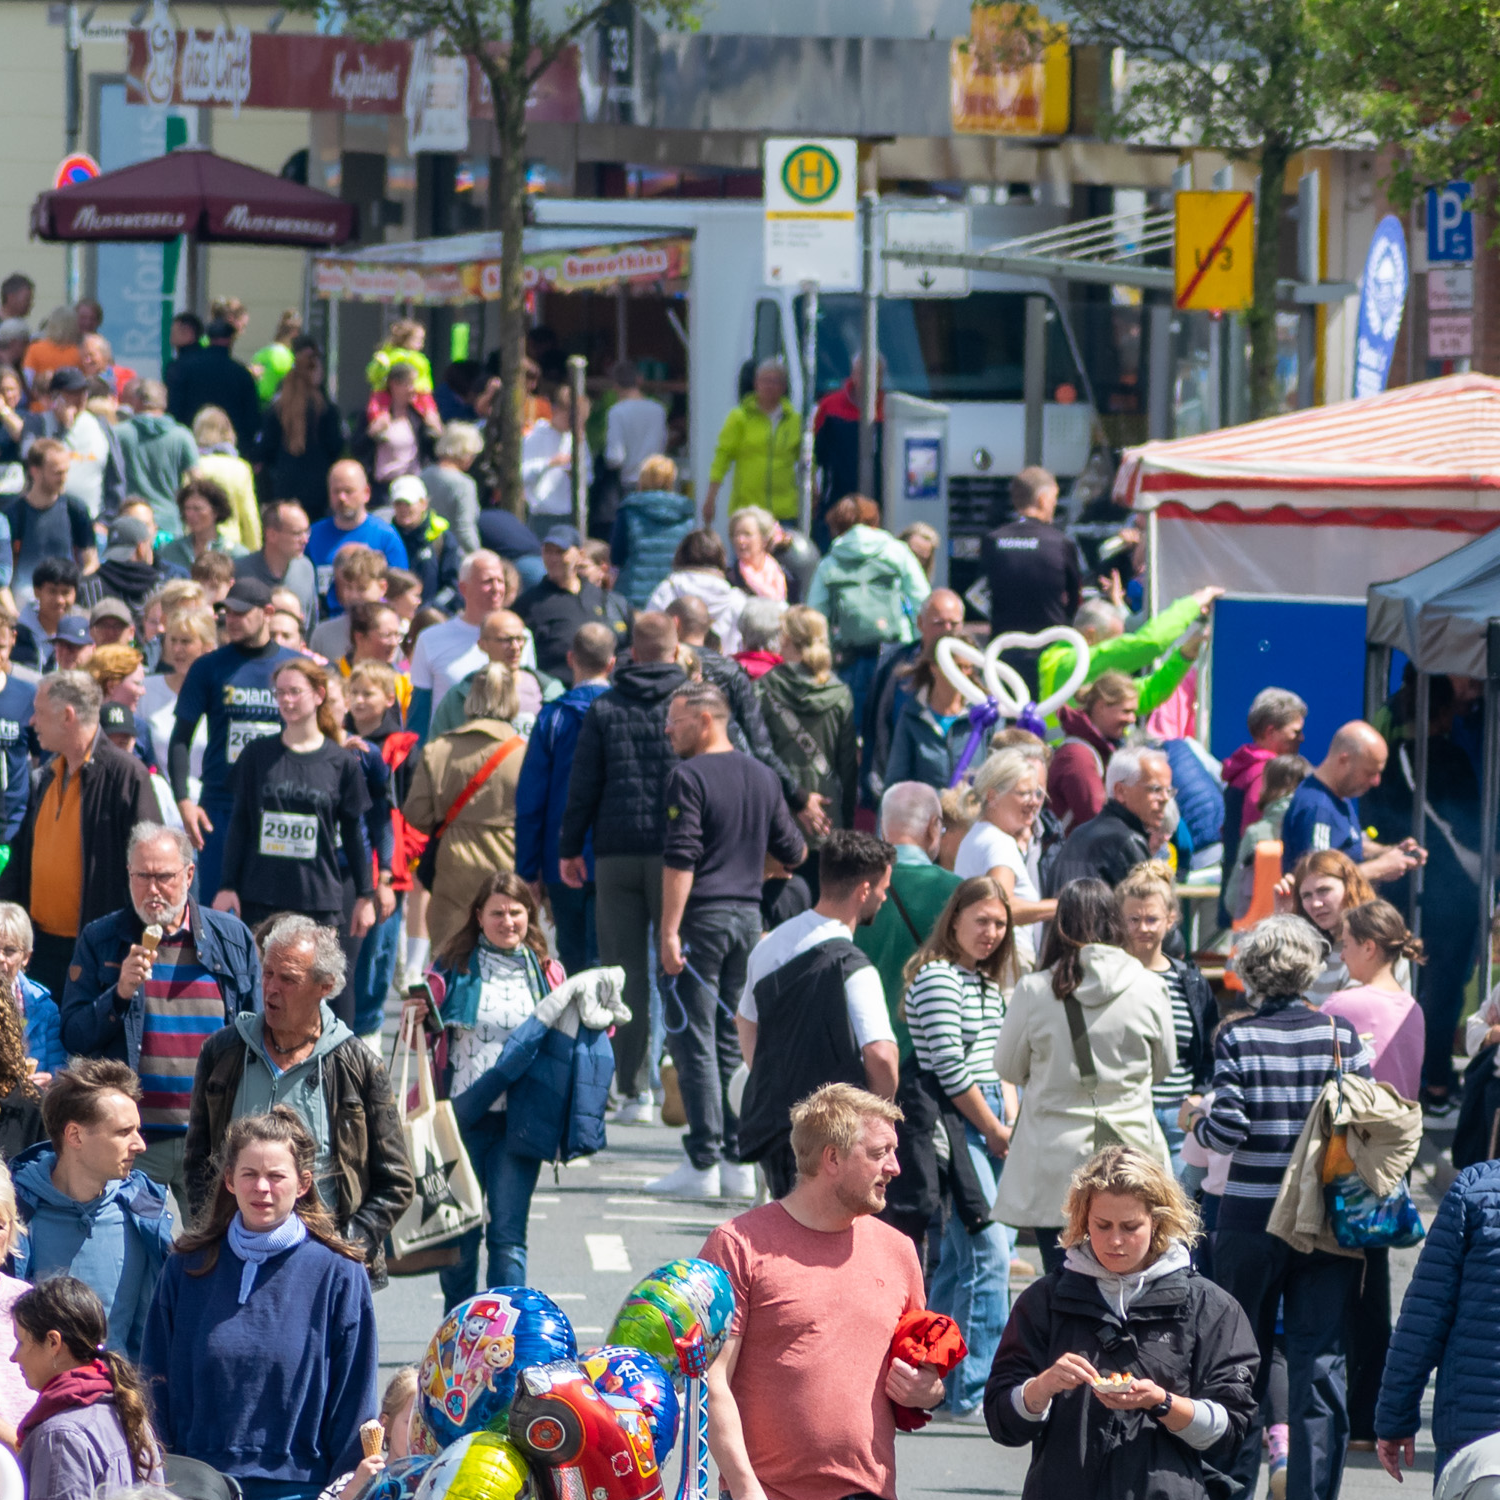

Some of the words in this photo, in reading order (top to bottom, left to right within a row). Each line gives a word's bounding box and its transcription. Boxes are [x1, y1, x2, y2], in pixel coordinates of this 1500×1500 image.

[799, 158, 824, 192] H
[1437, 190, 1463, 252] P
[564, 248, 665, 279] Smoothies
[263, 821, 317, 841] 2980
